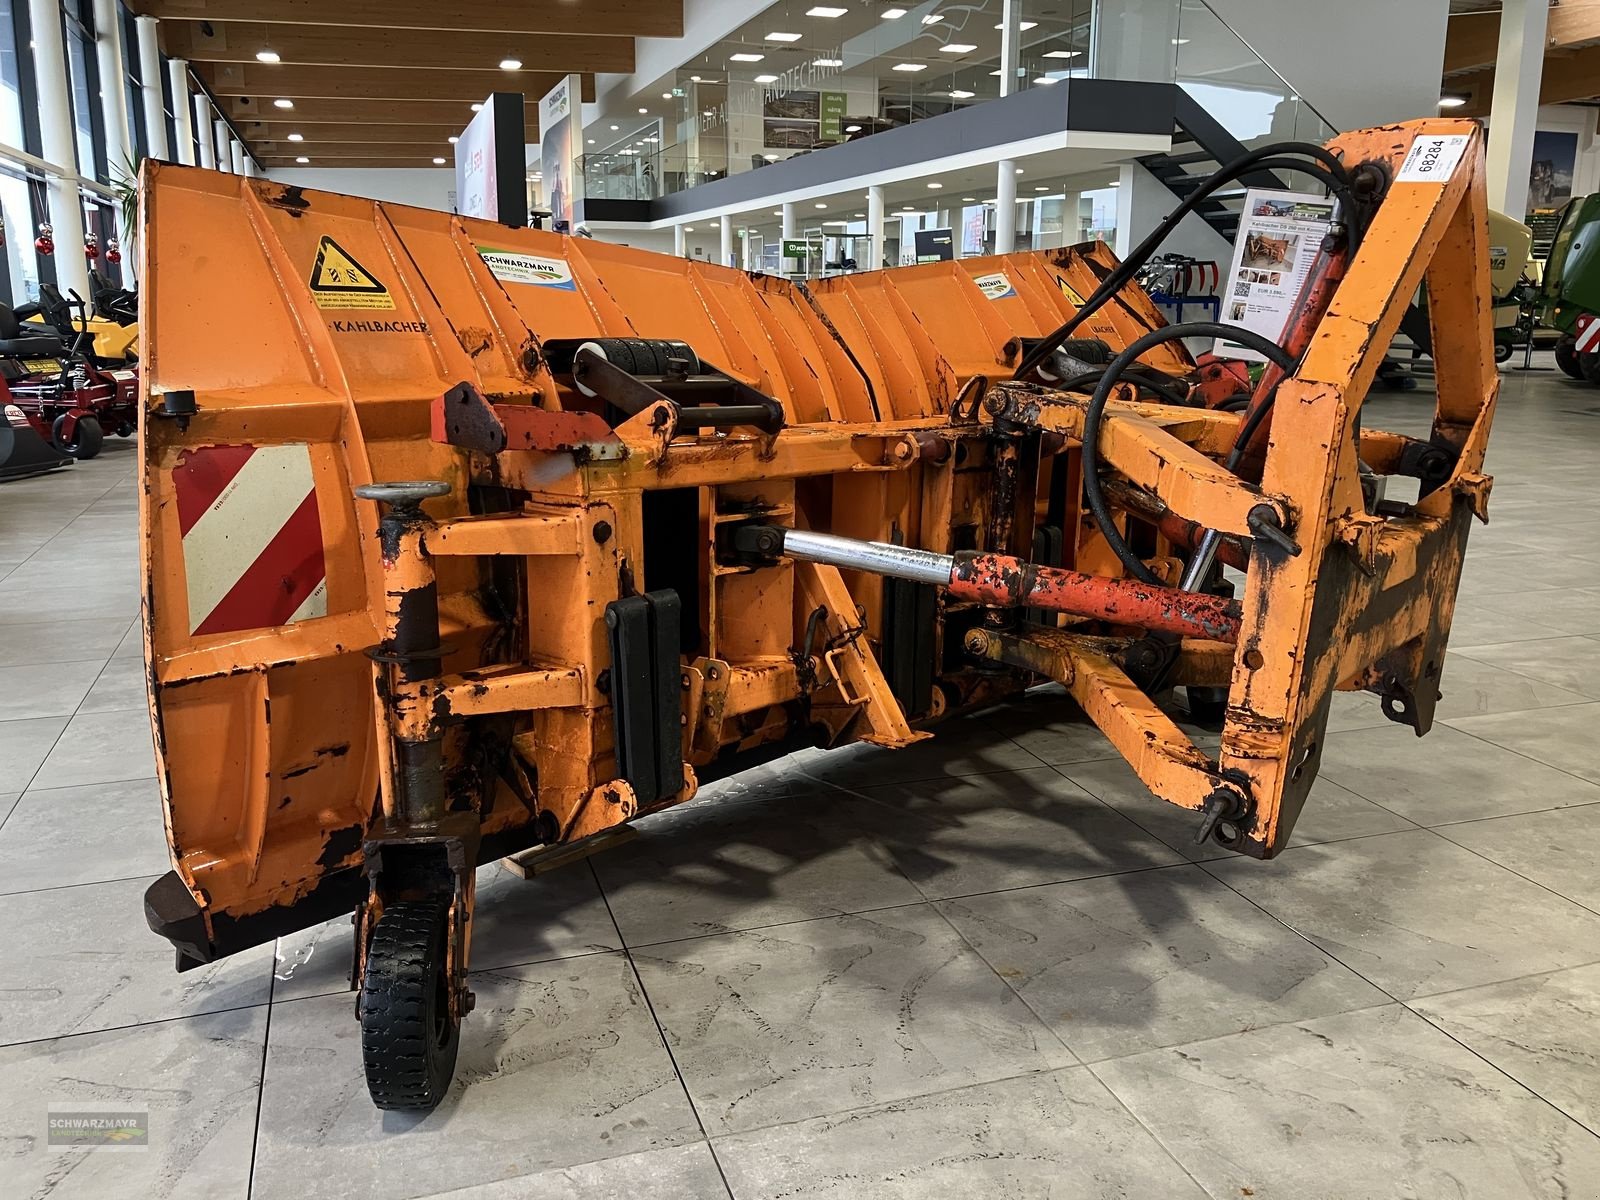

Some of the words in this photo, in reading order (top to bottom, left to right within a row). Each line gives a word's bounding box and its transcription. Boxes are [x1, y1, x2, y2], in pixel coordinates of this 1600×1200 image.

[760, 46, 839, 106] LANDTECHNIK
[1419, 140, 1445, 172] 68284
[483, 255, 555, 272] SCHWARZMAYR
[491, 264, 531, 274] ANDTECHNIK
[978, 280, 1002, 288] WARZMAYR
[333, 320, 428, 332] KAHLBACHER
